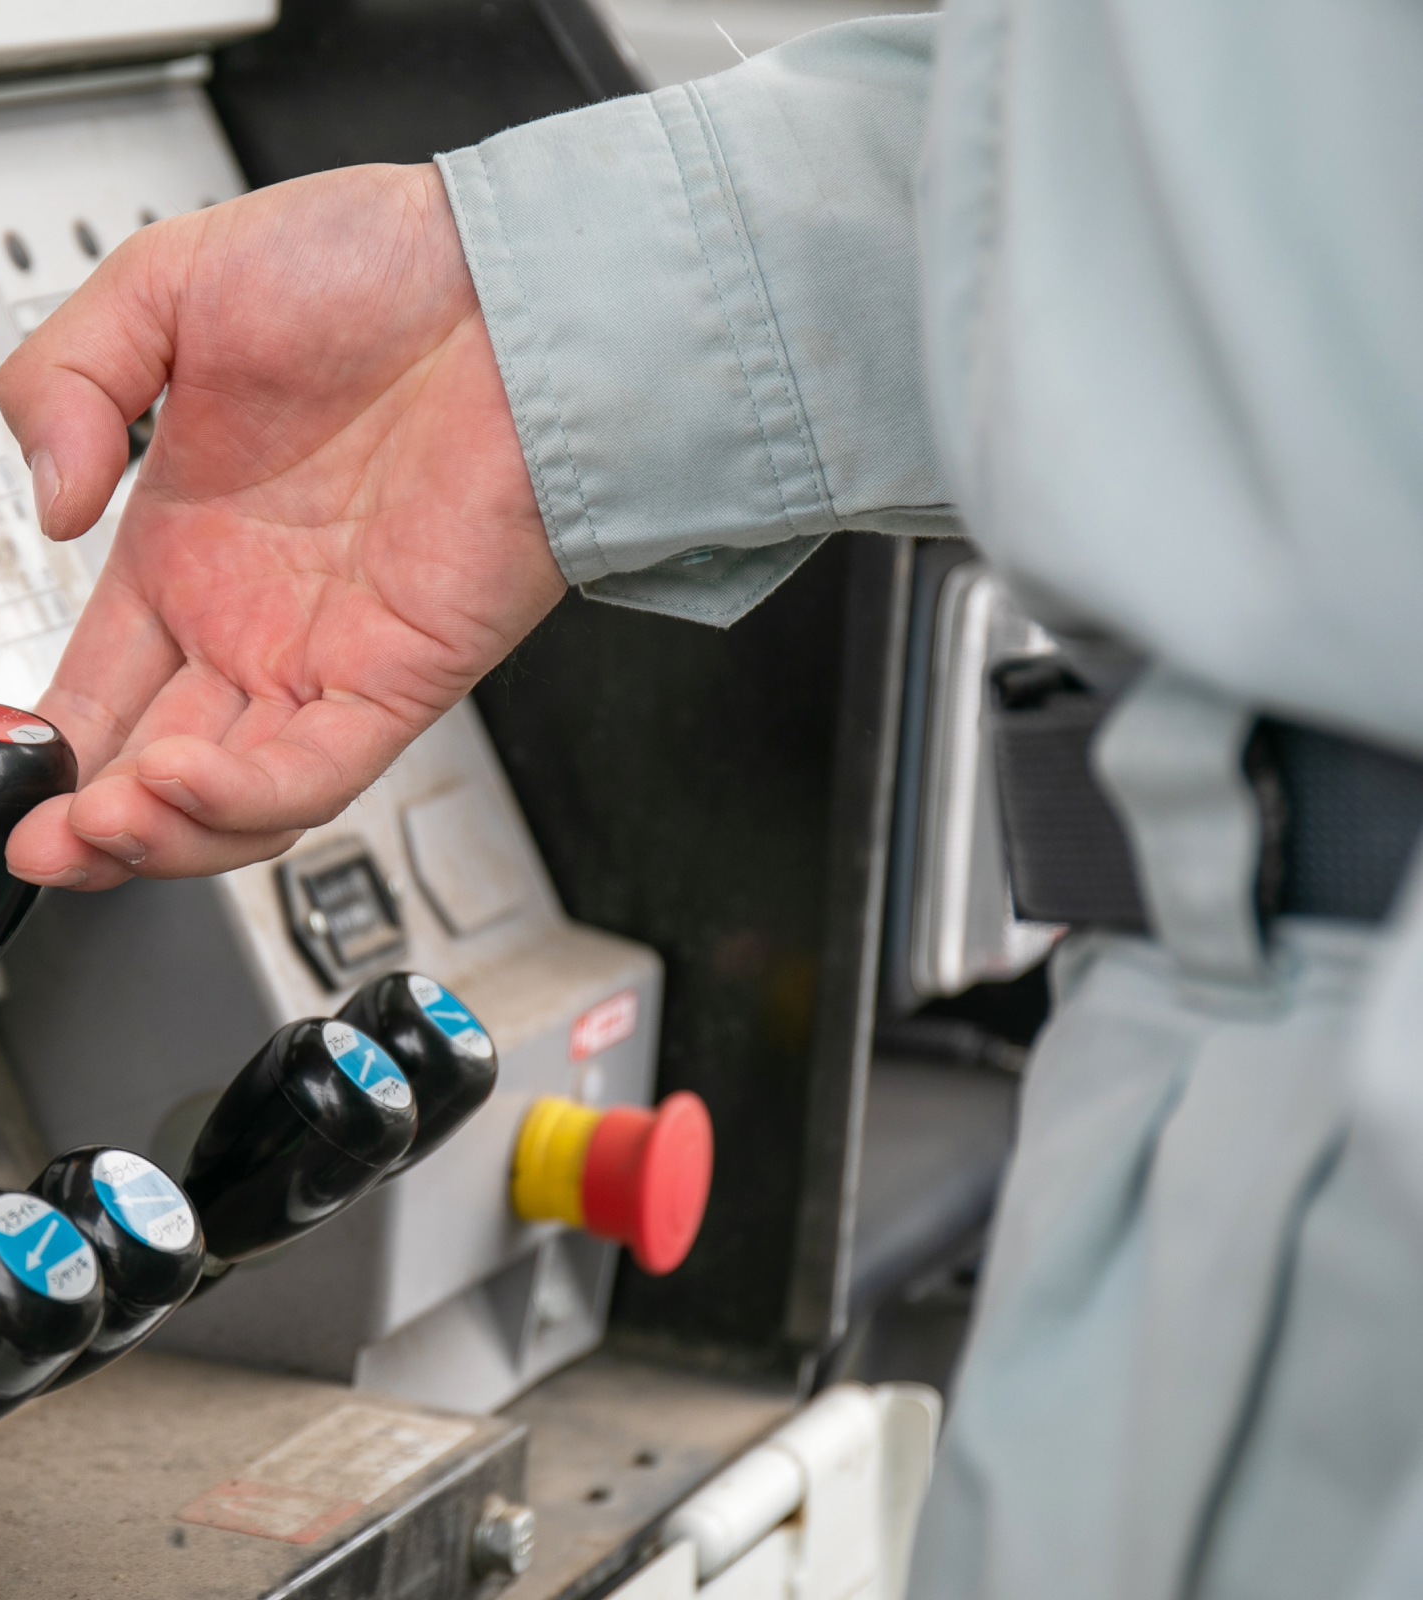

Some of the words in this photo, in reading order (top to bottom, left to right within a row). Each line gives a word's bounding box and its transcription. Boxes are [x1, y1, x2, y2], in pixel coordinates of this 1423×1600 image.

[328, 1030, 353, 1052] スライド
[103, 1156, 143, 1185] スライド
[151, 1214, 189, 1242] ジャッキ
[50, 1256, 90, 1290] ジャッキ
